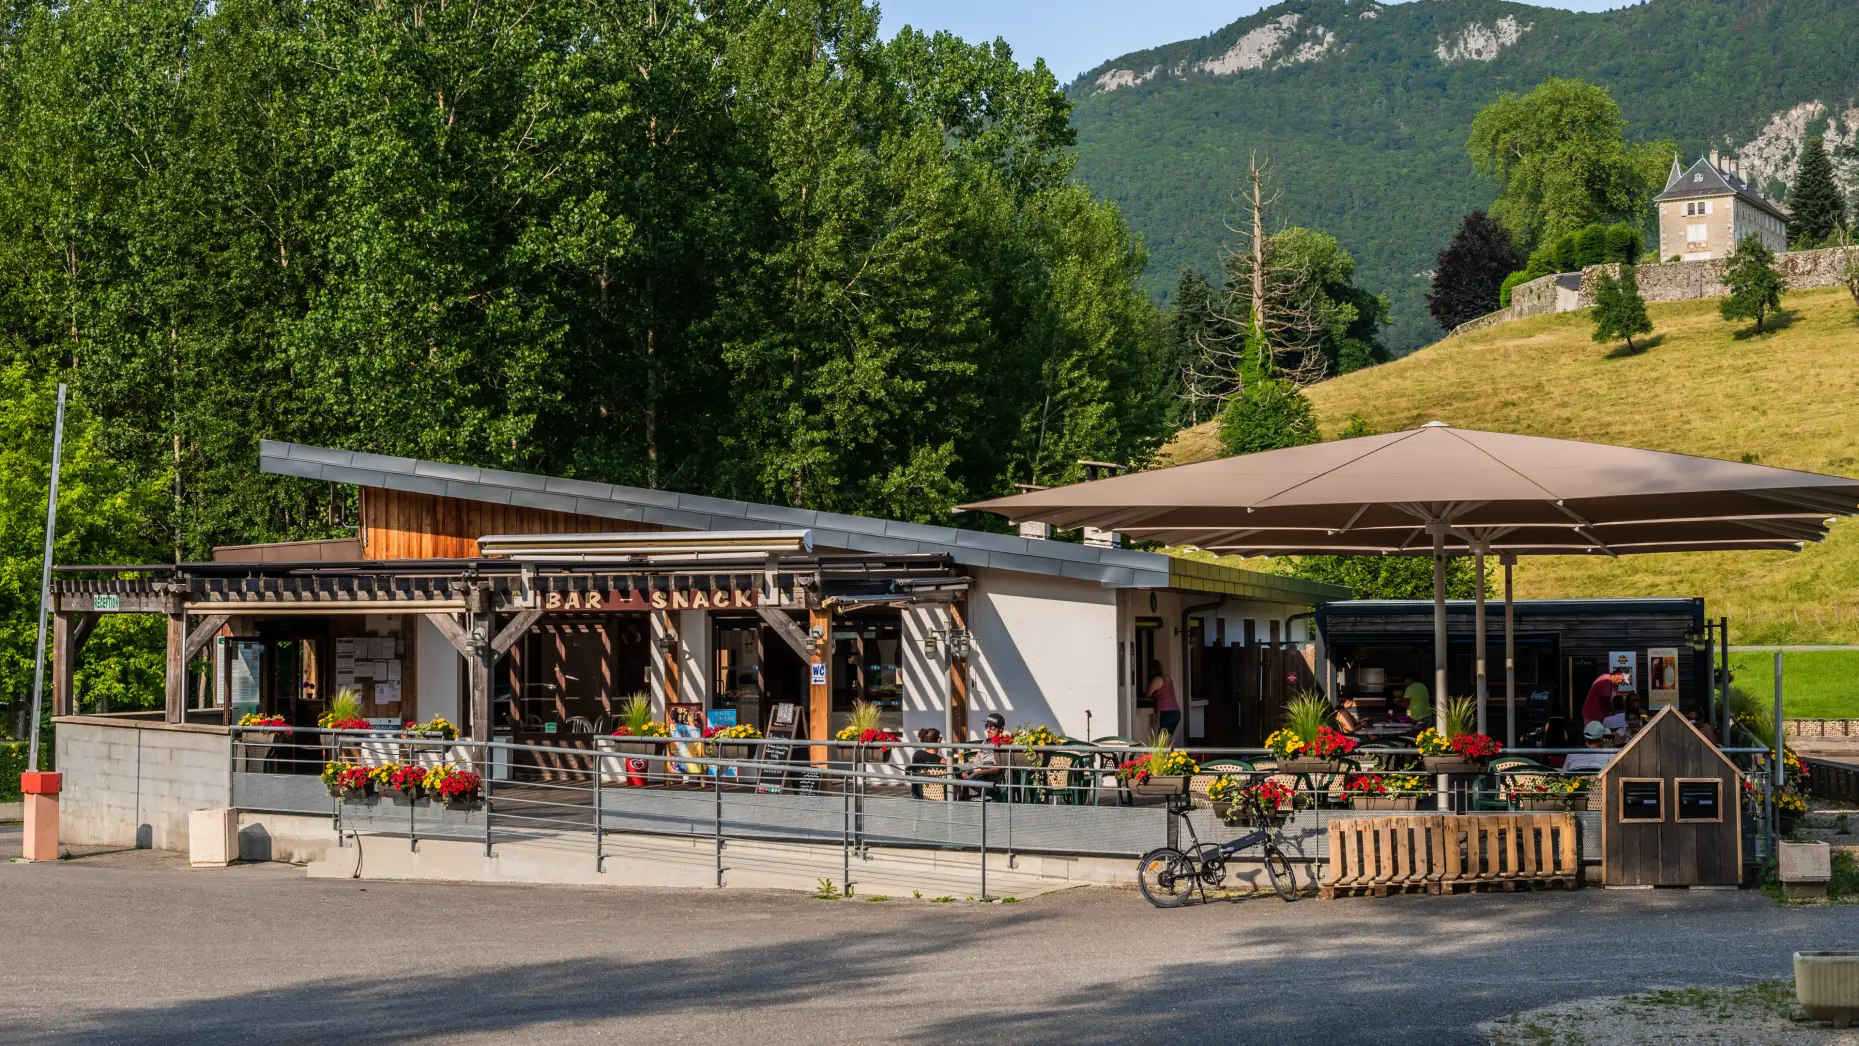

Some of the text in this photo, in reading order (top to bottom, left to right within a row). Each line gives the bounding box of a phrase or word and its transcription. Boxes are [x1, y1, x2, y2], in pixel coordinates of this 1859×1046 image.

[546, 592, 602, 610] BAR
[651, 590, 752, 609] SNACK
[813, 665, 825, 676] WC
